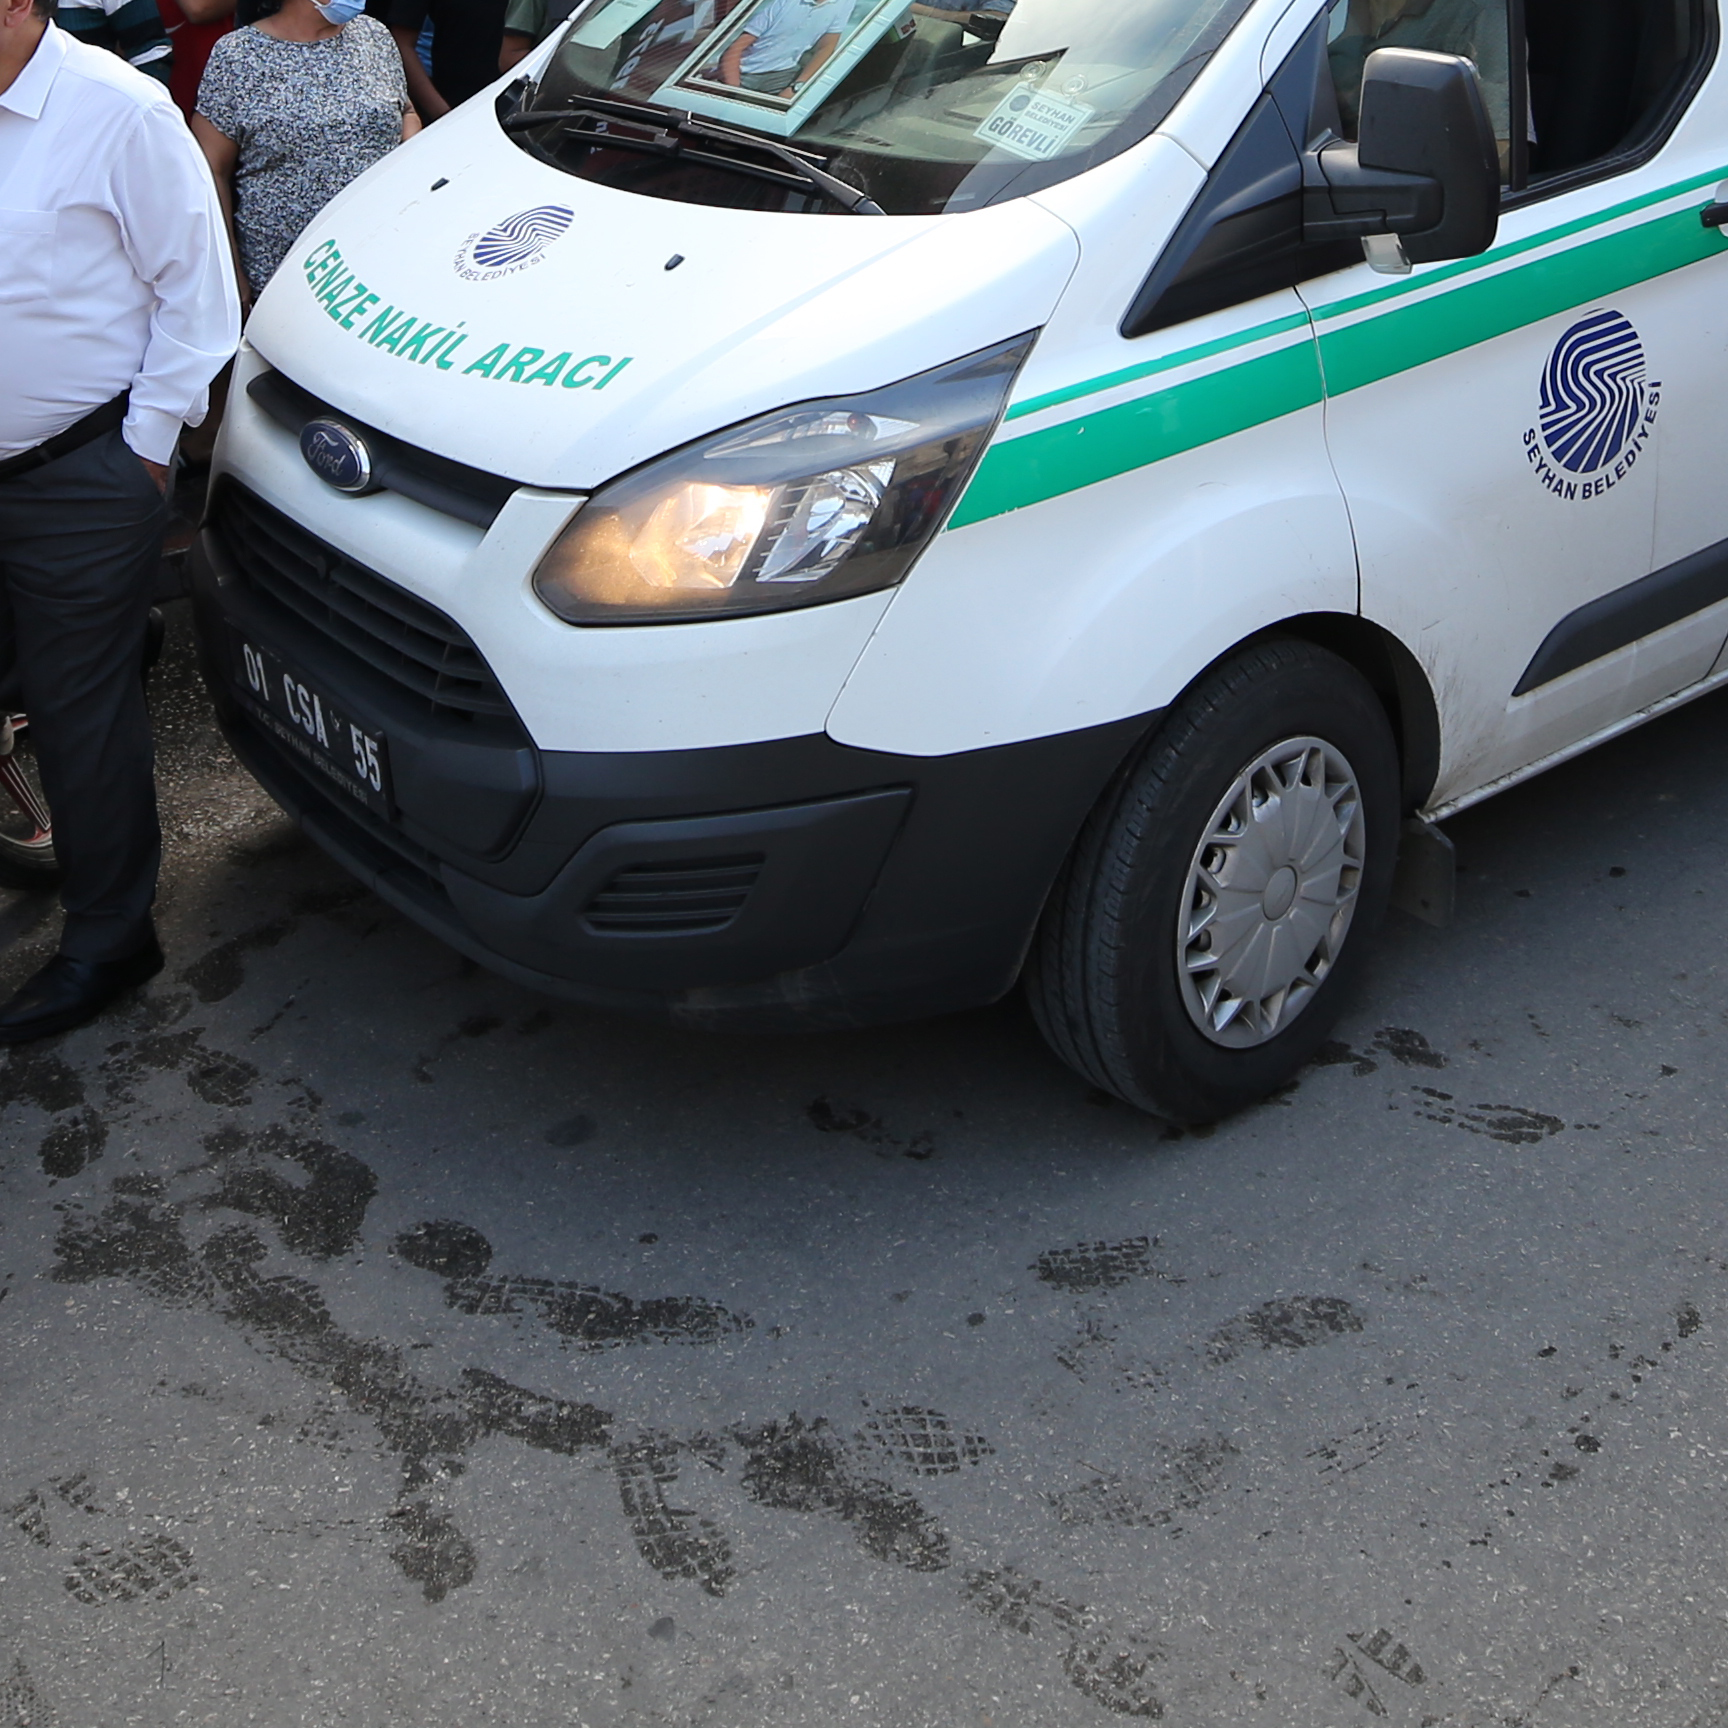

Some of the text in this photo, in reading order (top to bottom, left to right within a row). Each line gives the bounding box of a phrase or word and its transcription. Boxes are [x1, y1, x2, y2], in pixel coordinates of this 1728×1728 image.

[987, 116, 1059, 154] GÖREVLİ
[1030, 101, 1077, 123] SEYHAN
[303, 238, 635, 390] CENAZE NAKİL ARACI
[307, 430, 345, 477] Ford
[1522, 380, 1663, 501] SEYHAN BELEDİYESİ
[243, 643, 382, 793] 01 CSA 55
